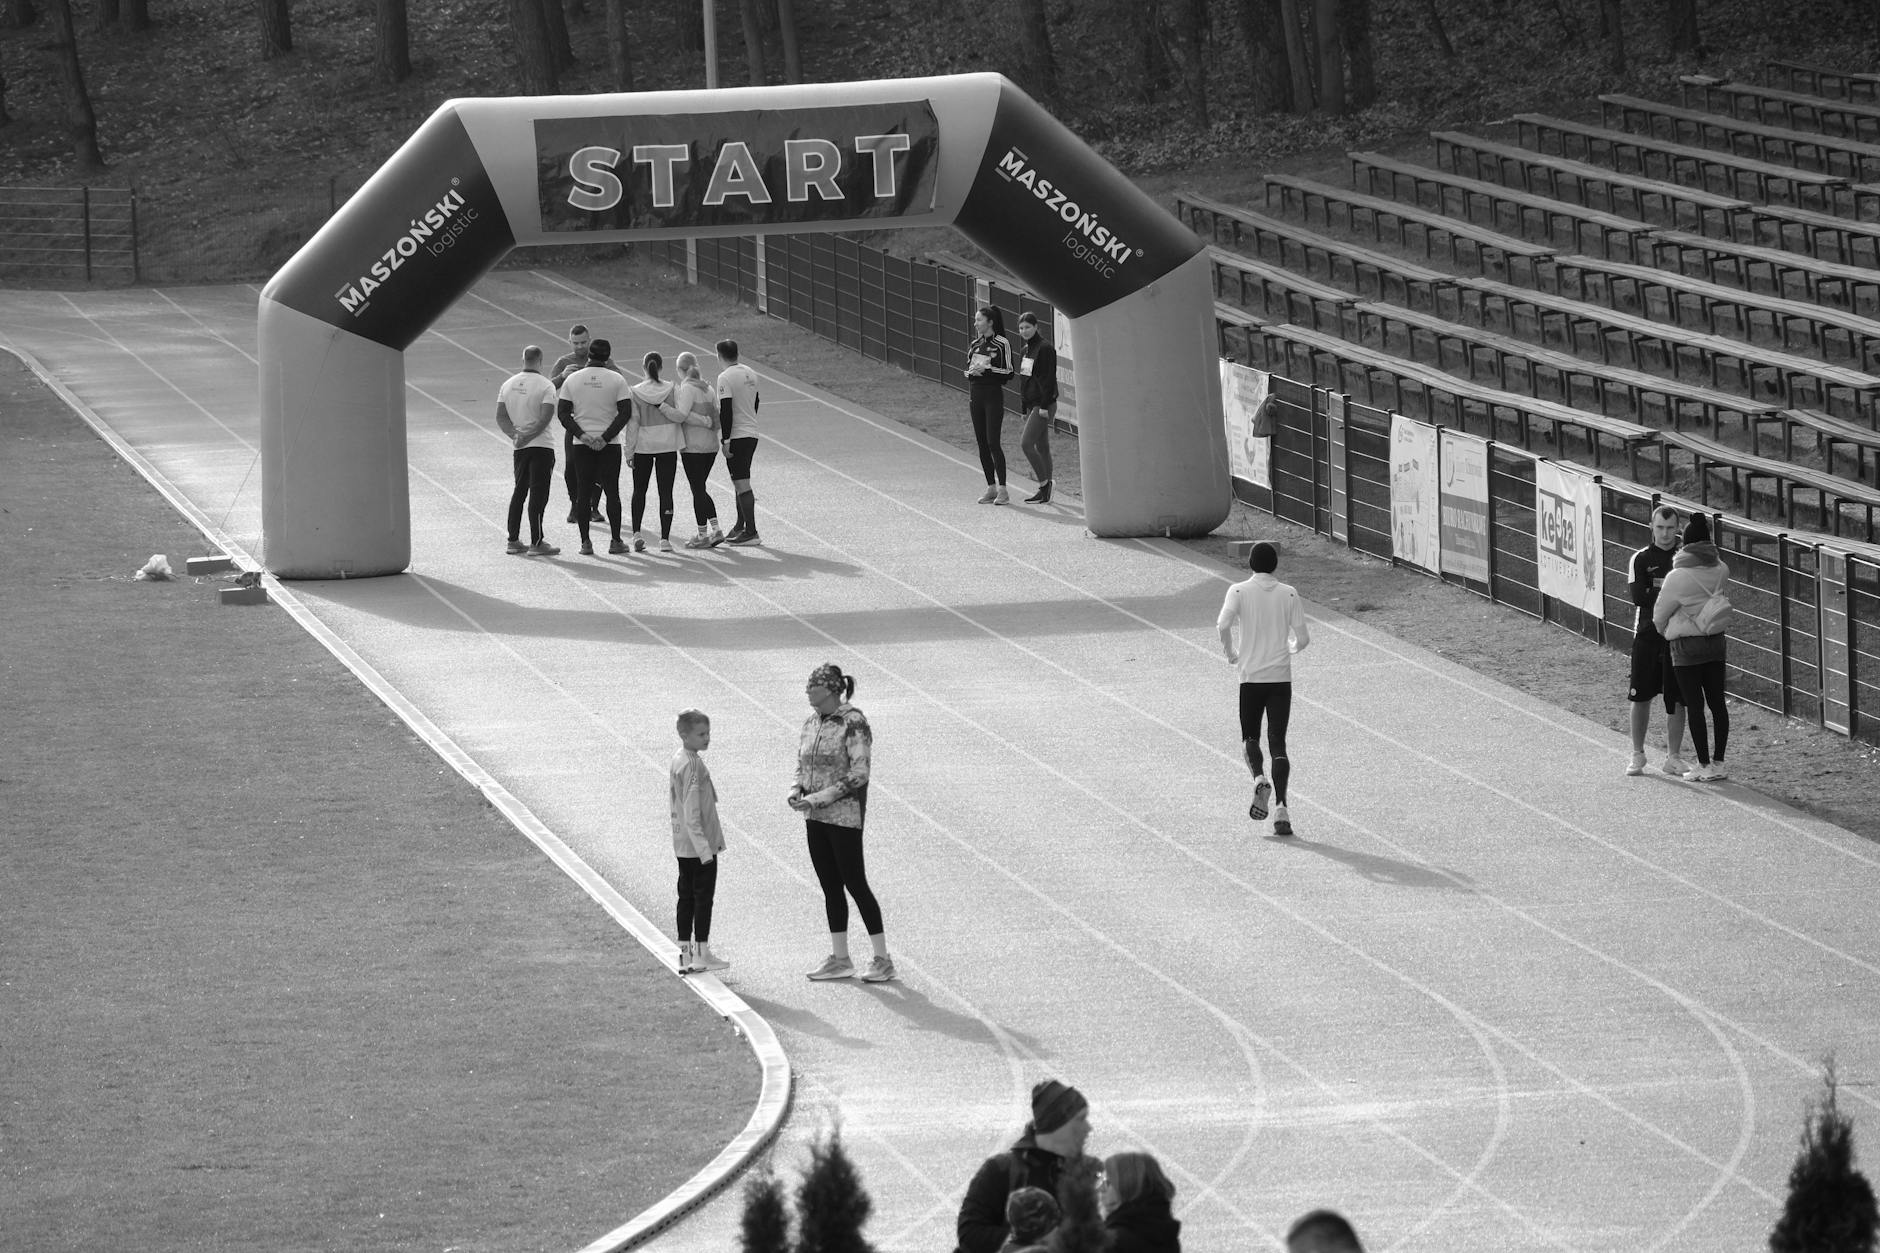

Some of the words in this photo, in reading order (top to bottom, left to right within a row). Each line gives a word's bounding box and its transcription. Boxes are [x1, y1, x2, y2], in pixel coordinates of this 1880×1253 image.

[567, 133, 911, 211] START
[426, 208, 479, 257] logistic
[1062, 231, 1115, 279] logistic
